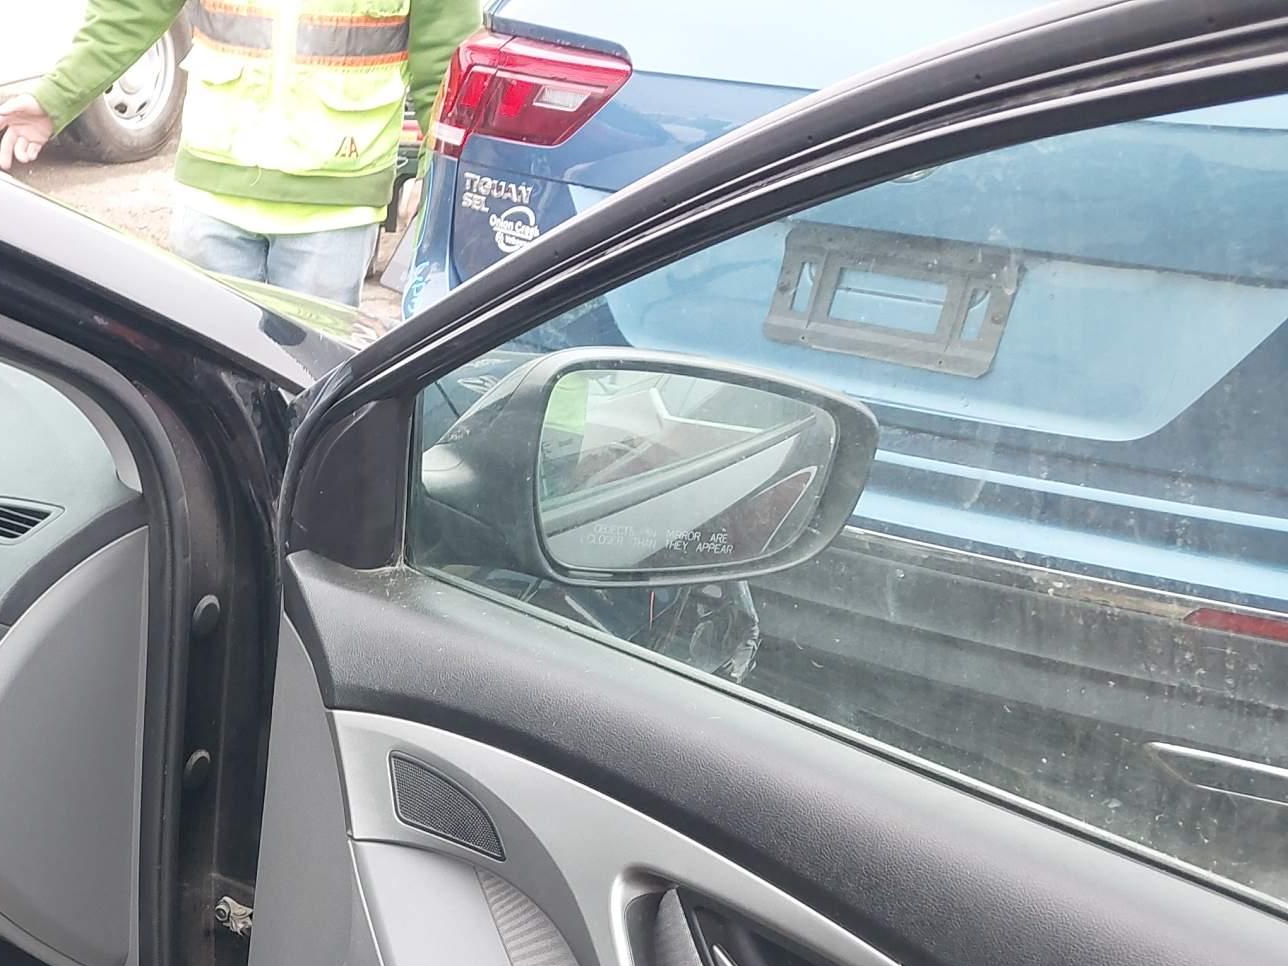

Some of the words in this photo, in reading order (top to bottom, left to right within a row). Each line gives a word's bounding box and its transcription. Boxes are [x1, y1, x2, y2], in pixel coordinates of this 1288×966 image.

[464, 171, 534, 204] TIGUAN
[461, 192, 490, 213] SEL
[665, 539, 689, 551] THEY
[696, 542, 734, 554] APPEAR
[709, 533, 729, 544] ARE
